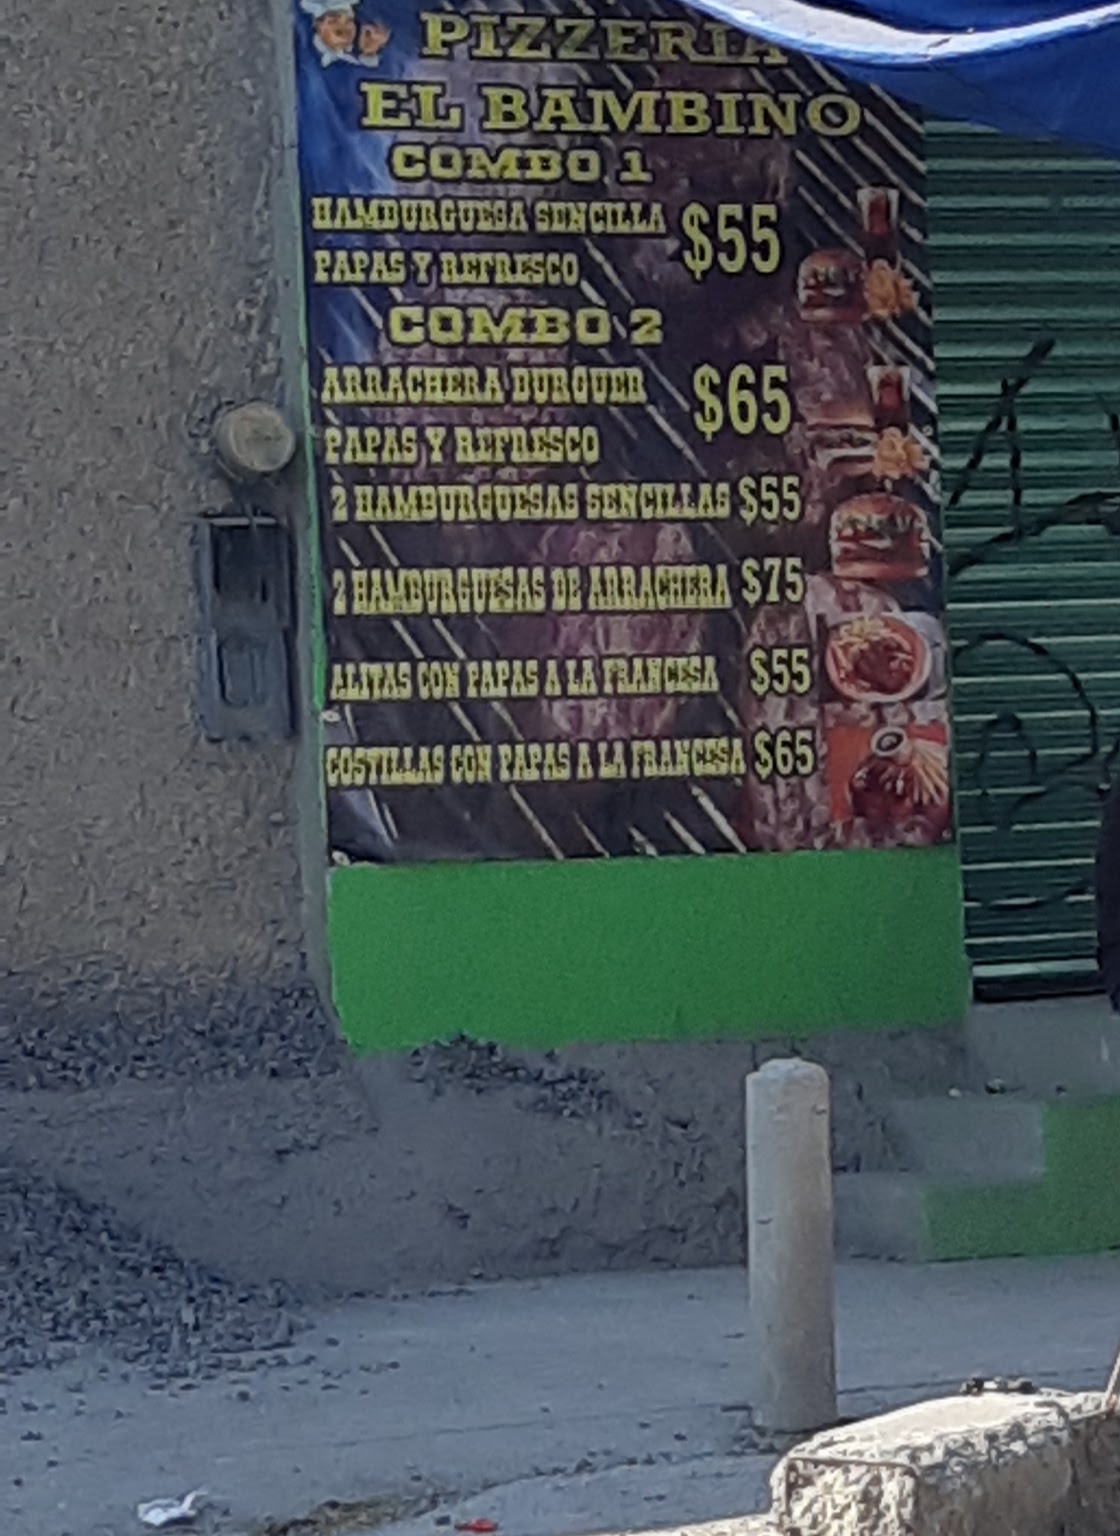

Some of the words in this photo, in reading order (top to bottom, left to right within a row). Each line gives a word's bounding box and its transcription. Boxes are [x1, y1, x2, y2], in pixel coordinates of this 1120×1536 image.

[359, 82, 462, 130] EL
[482, 87, 863, 137] BAMBINO
[390, 145, 601, 182] COMBO
[618, 150, 653, 183] 1
[310, 196, 529, 232] HAMBURGUESA
[535, 202, 667, 235] SENCILLA
[680, 201, 783, 281] $55
[313, 250, 406, 285] PAPAS
[412, 252, 433, 284] Y
[439, 251, 580, 286] REFRESCO
[388, 306, 612, 346] COMBO
[630, 309, 663, 345] 2
[321, 366, 501, 406] ARRACHERA
[510, 367, 648, 405] BURGUER
[692, 363, 793, 442] $65
[324, 427, 418, 464] PAPAS
[427, 428, 447, 463] Y
[454, 426, 600, 464] REFRESCO
[331, 486, 349, 522] 2
[354, 485, 579, 521] HAMBURGUESAS
[586, 483, 731, 520] SENCILLAS
[737, 475, 801, 526] $55
[332, 570, 348, 615] 2
[352, 568, 545, 615] HAMBURGUESAS
[551, 568, 583, 612] DE
[588, 565, 733, 611] ARRACHERA
[740, 557, 806, 606] $75
[330, 664, 411, 700] ALITAS
[417, 663, 461, 700] CON
[467, 660, 540, 698] PAPAS
[544, 659, 562, 696] A
[566, 659, 599, 695] LA
[603, 657, 721, 694] FRANCESA
[750, 648, 812, 696] $55
[325, 746, 444, 785] COSTILLAS
[450, 745, 493, 783] CON
[499, 742, 571, 782] PAPAS
[576, 741, 595, 780] A
[599, 740, 627, 779] LA
[631, 737, 747, 779] FRANCESA
[754, 728, 815, 780] $65
